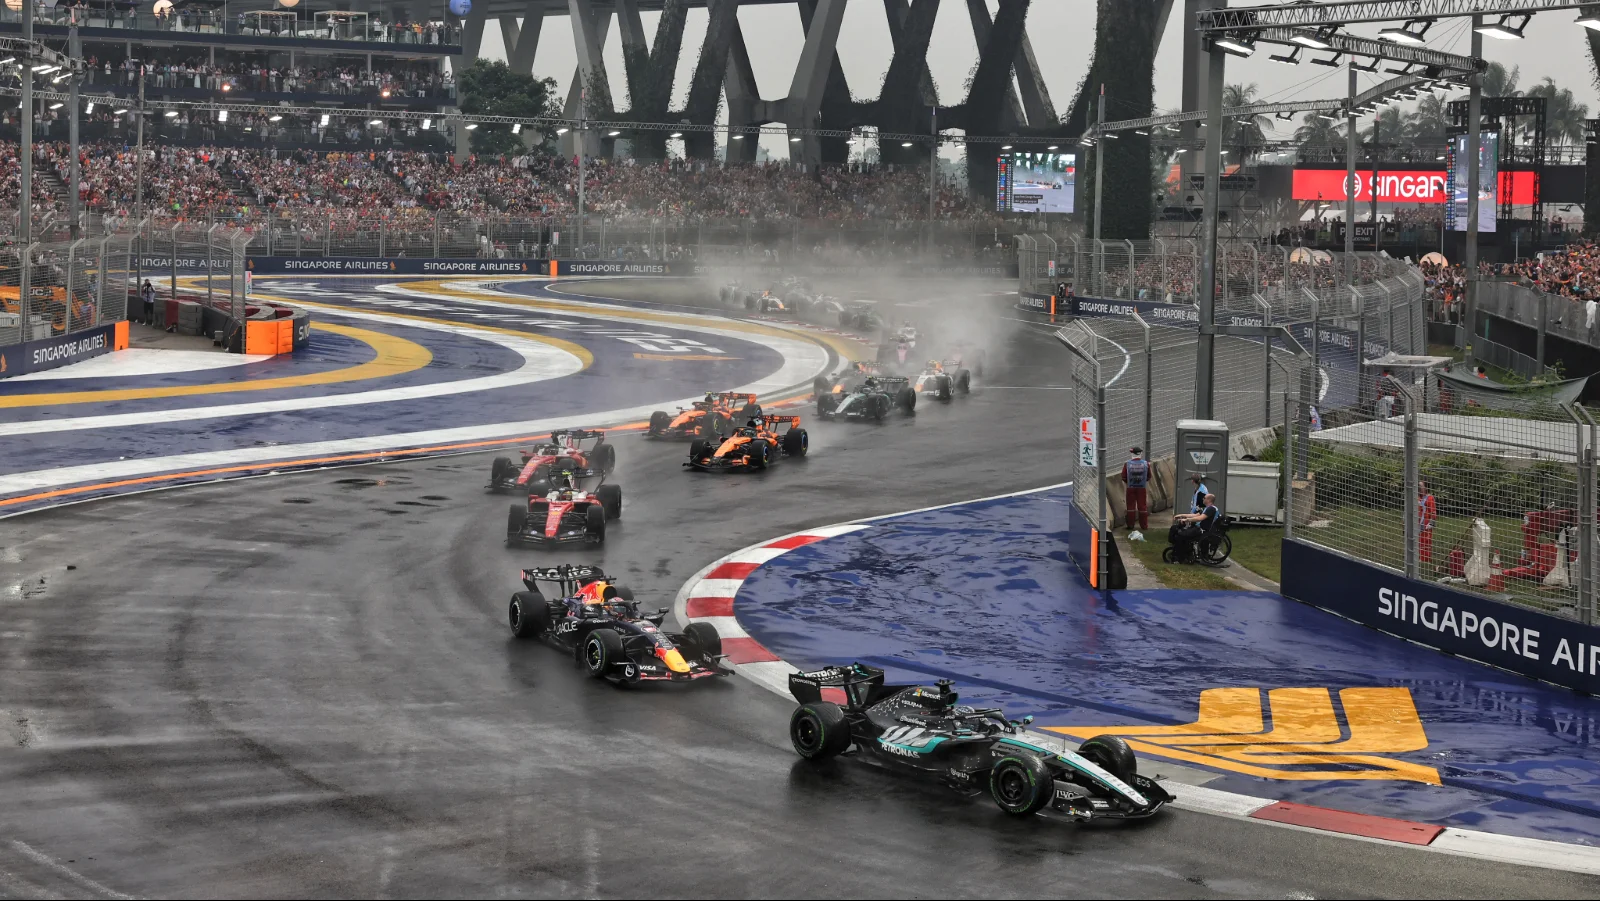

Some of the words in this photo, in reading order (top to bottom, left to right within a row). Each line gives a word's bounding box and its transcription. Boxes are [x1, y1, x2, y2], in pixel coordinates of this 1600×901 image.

[1355, 227, 1374, 236] EXIT
[285, 260, 341, 269] SINGAPORE
[344, 261, 388, 270] AIRLINES
[423, 262, 476, 271] SINGAPORE
[479, 263, 520, 271] AIRLINES
[570, 264, 621, 272] SINGAPORE
[623, 265, 663, 273] AIRLINES
[968, 267, 1001, 276] AIRLINES
[1079, 302, 1107, 313] SINGAPORE
[1109, 305, 1134, 315] AIRLINES
[33, 344, 77, 364] SINGAPORE
[77, 334, 104, 354] AIRLINES
[556, 620, 578, 635] ORACLE
[1378, 587, 1540, 660] SINGAPORE
[921, 690, 942, 701] Microsoft
[881, 742, 920, 759] PETRONAS
